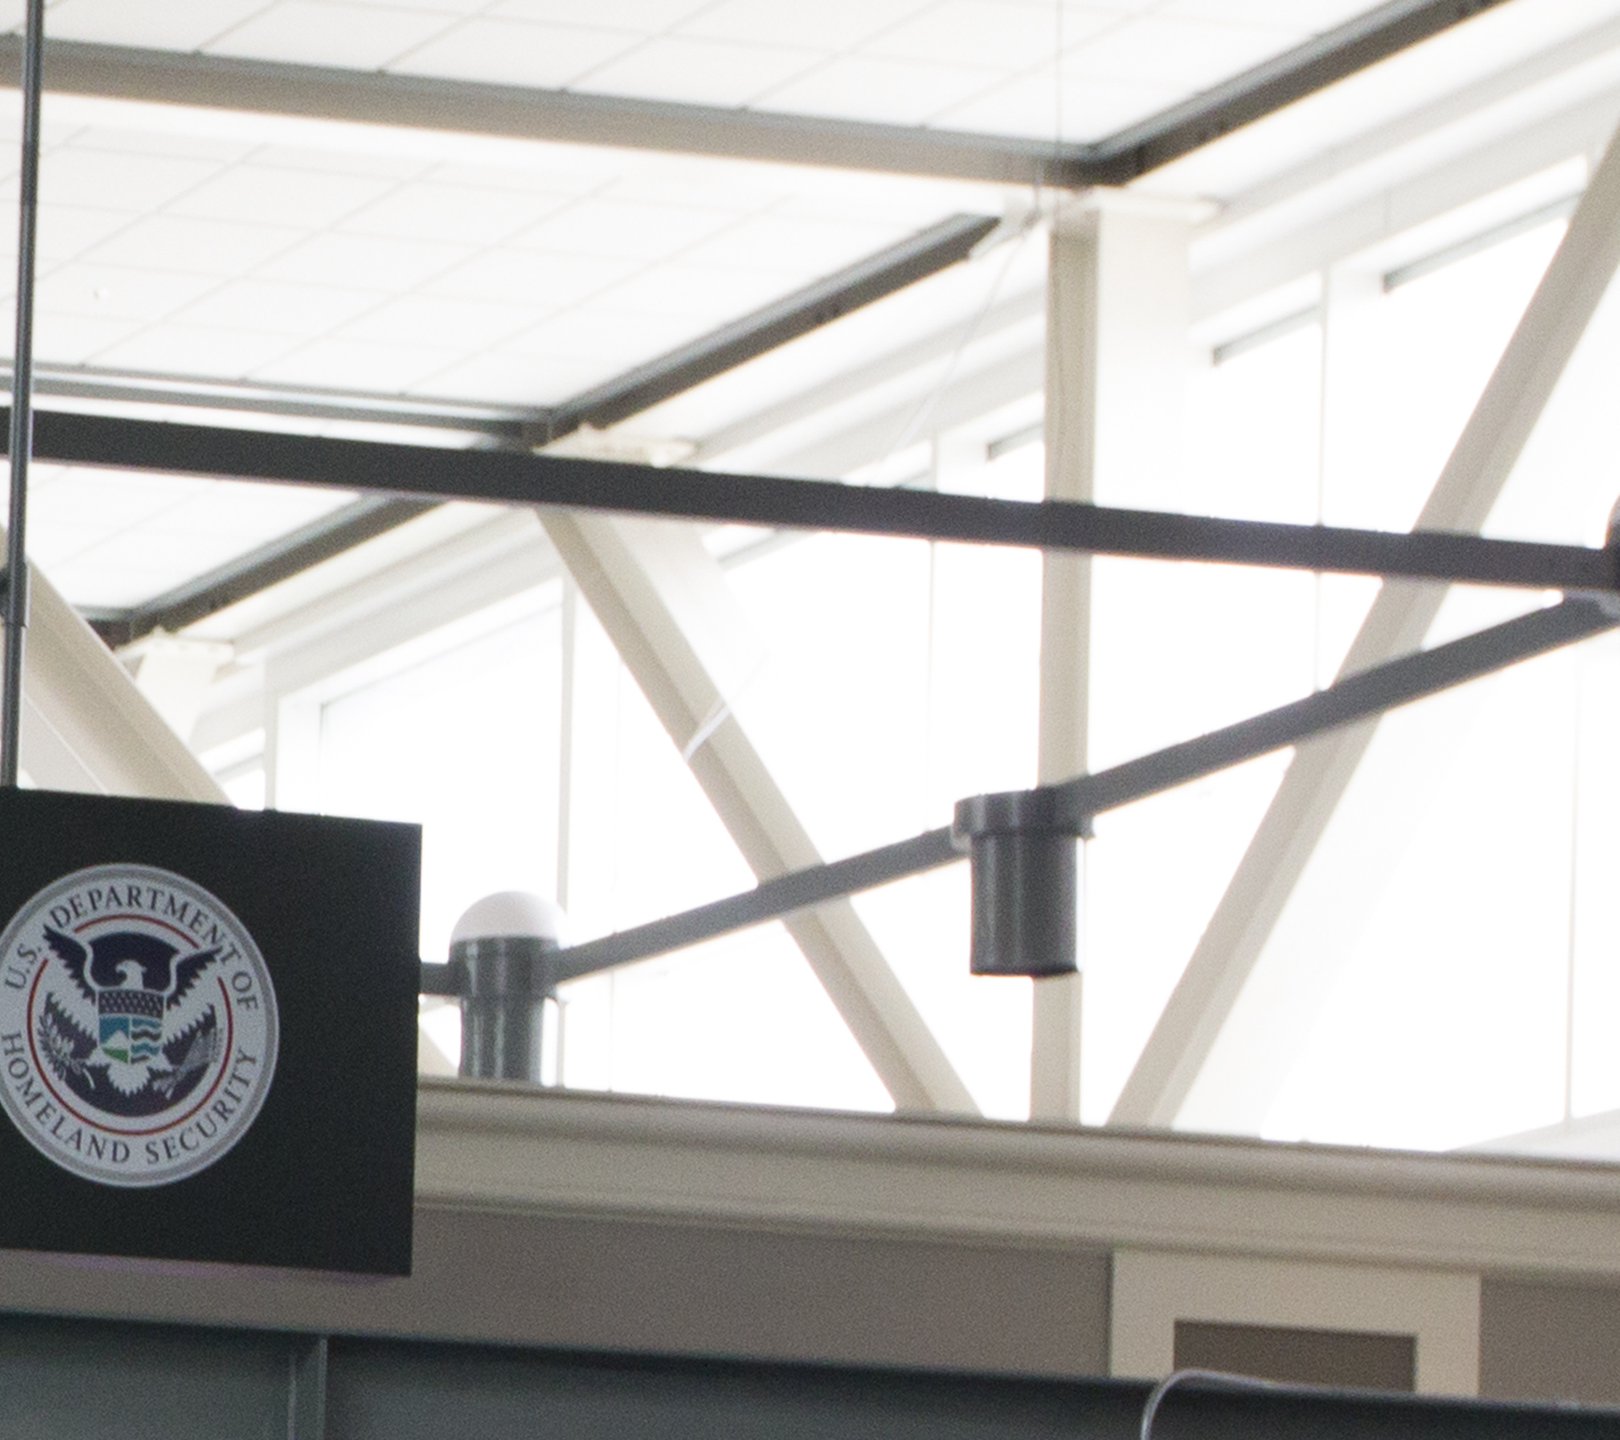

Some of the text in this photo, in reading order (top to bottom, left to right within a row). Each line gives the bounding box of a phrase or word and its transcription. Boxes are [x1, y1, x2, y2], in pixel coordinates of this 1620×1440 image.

[4, 883, 259, 1012] U.S. DEPARTMENT OF
[0, 1029, 257, 1166] HOMELAND SECURITY
